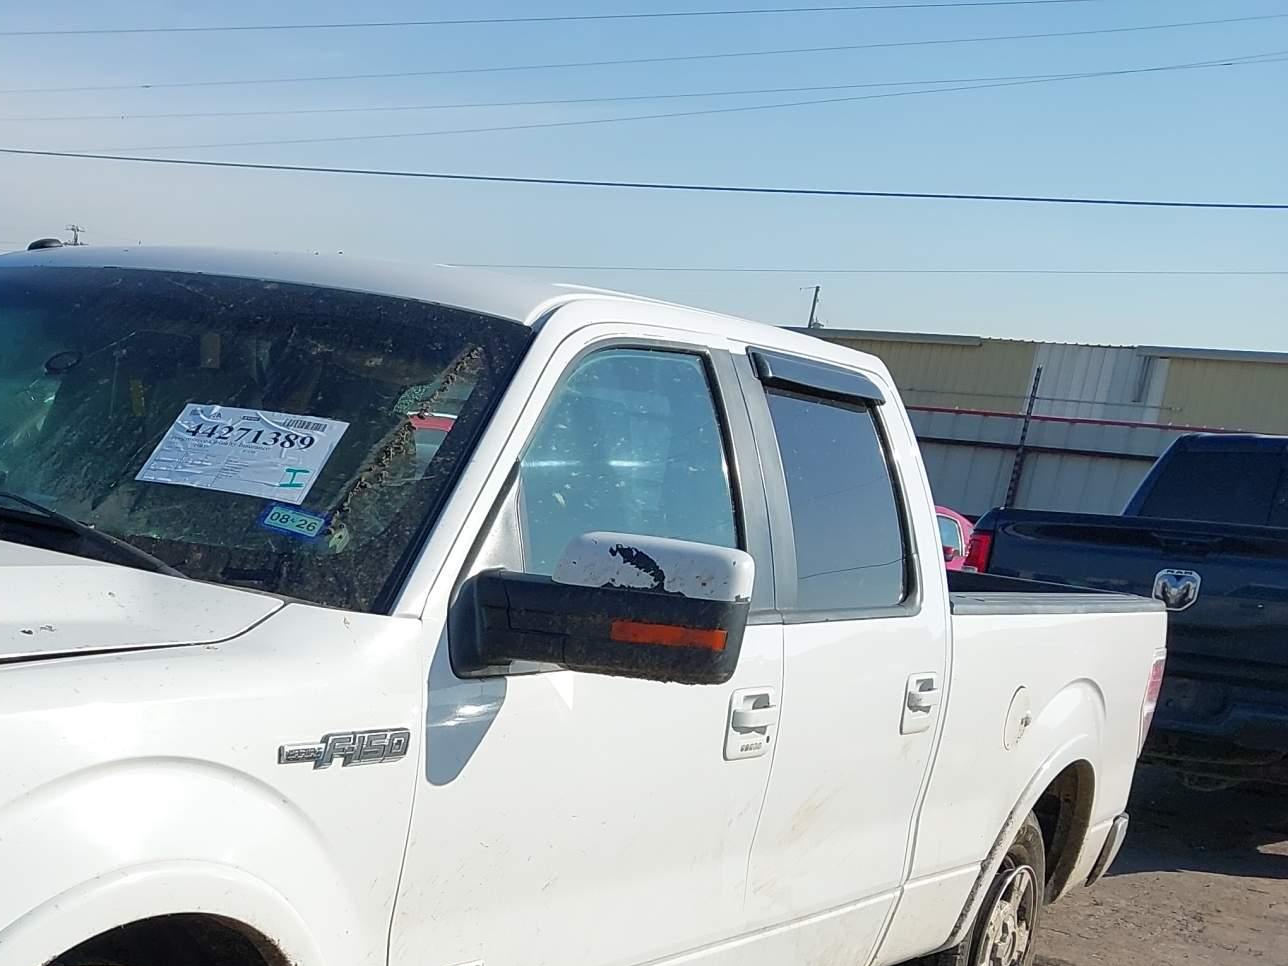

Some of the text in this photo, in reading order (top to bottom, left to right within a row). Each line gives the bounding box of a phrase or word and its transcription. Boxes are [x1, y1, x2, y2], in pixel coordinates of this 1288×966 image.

[186, 422, 316, 450] 44271389
[270, 510, 318, 532] 08 26
